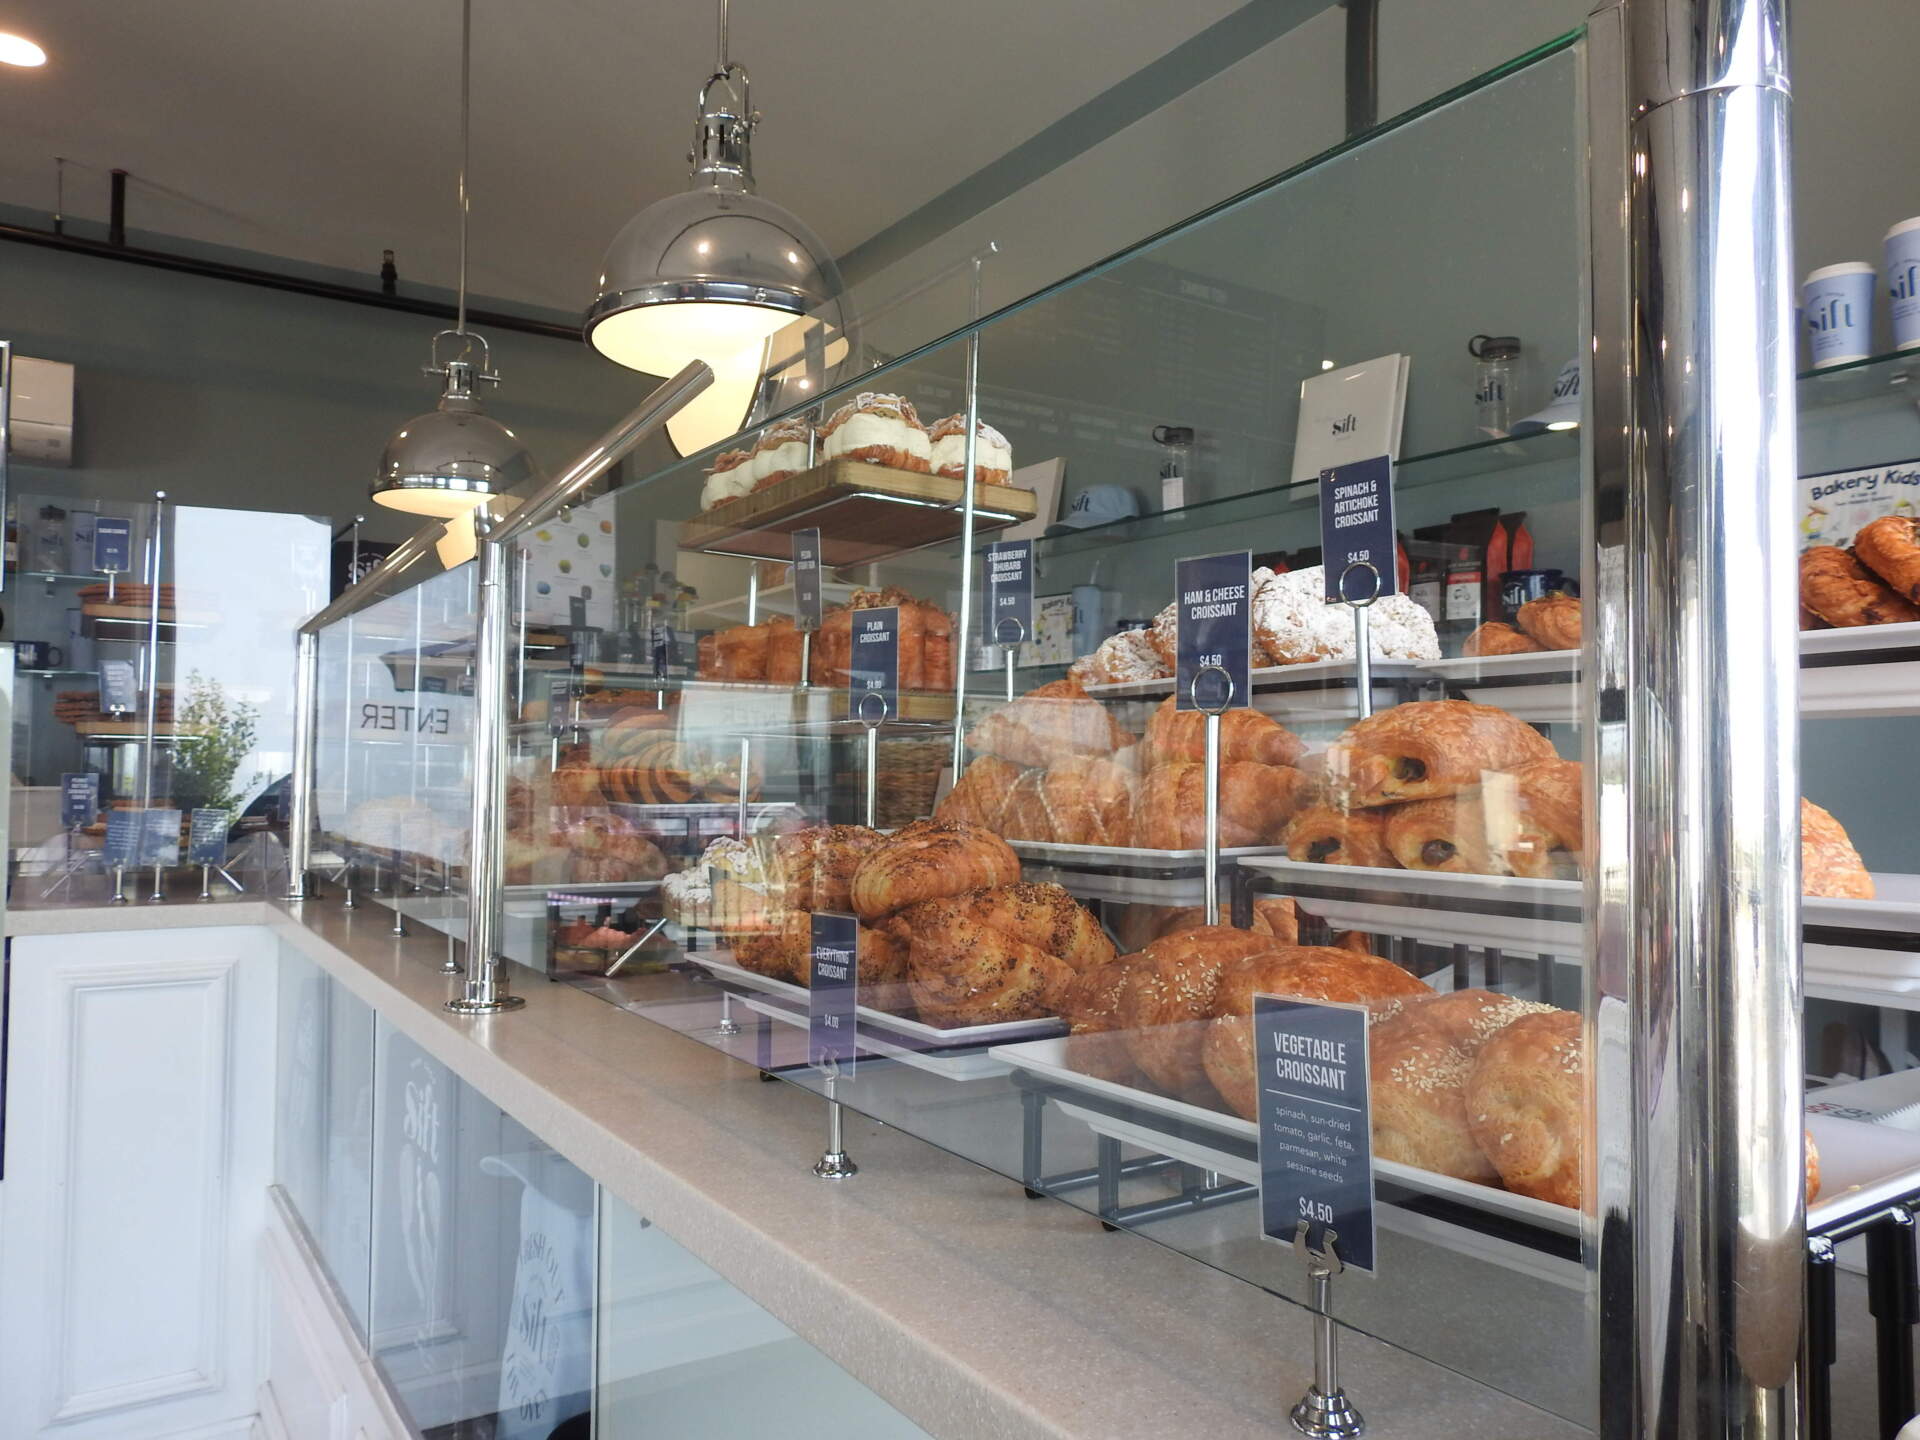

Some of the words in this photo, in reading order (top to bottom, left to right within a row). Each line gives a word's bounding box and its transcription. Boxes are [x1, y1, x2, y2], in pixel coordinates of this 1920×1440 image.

[1333, 482, 1370, 500] SPINACH
[1370, 479, 1378, 493] &
[1811, 474, 1879, 501] Bakery
[1333, 494, 1379, 515] ARTICHOKE
[1334, 508, 1379, 529] CROISSANT
[987, 549, 1028, 562] STRAWBERRY
[1346, 549, 1371, 564] $4.50
[990, 571, 1022, 583] CROISSANT
[993, 561, 1021, 572] RHUBARB
[1183, 589, 1204, 605] HAM
[1204, 588, 1213, 603] &
[1212, 584, 1247, 602] CHEESE
[1190, 602, 1238, 620] CROISSANT
[866, 621, 883, 631] PLAIN
[859, 632, 890, 644] CROISSANT
[1198, 654, 1222, 668] $4.50
[816, 946, 849, 964] EVERYTHING
[817, 962, 847, 980] CROISSANT
[1273, 1032, 1346, 1065] VEGETABLE
[1276, 1058, 1346, 1091] CROISSANT
[1275, 1106, 1309, 1121] spinach,
[1310, 1114, 1351, 1132] sun-dried
[1273, 1122, 1306, 1140] tomato,
[1308, 1130, 1333, 1147] garlic,
[1335, 1135, 1355, 1152] feta,
[1279, 1141, 1322, 1161] parmesan,
[1323, 1153, 1348, 1168] white
[1286, 1159, 1318, 1177] sesame
[1318, 1170, 1344, 1184] seeds
[1299, 1196, 1333, 1225] $4.50
